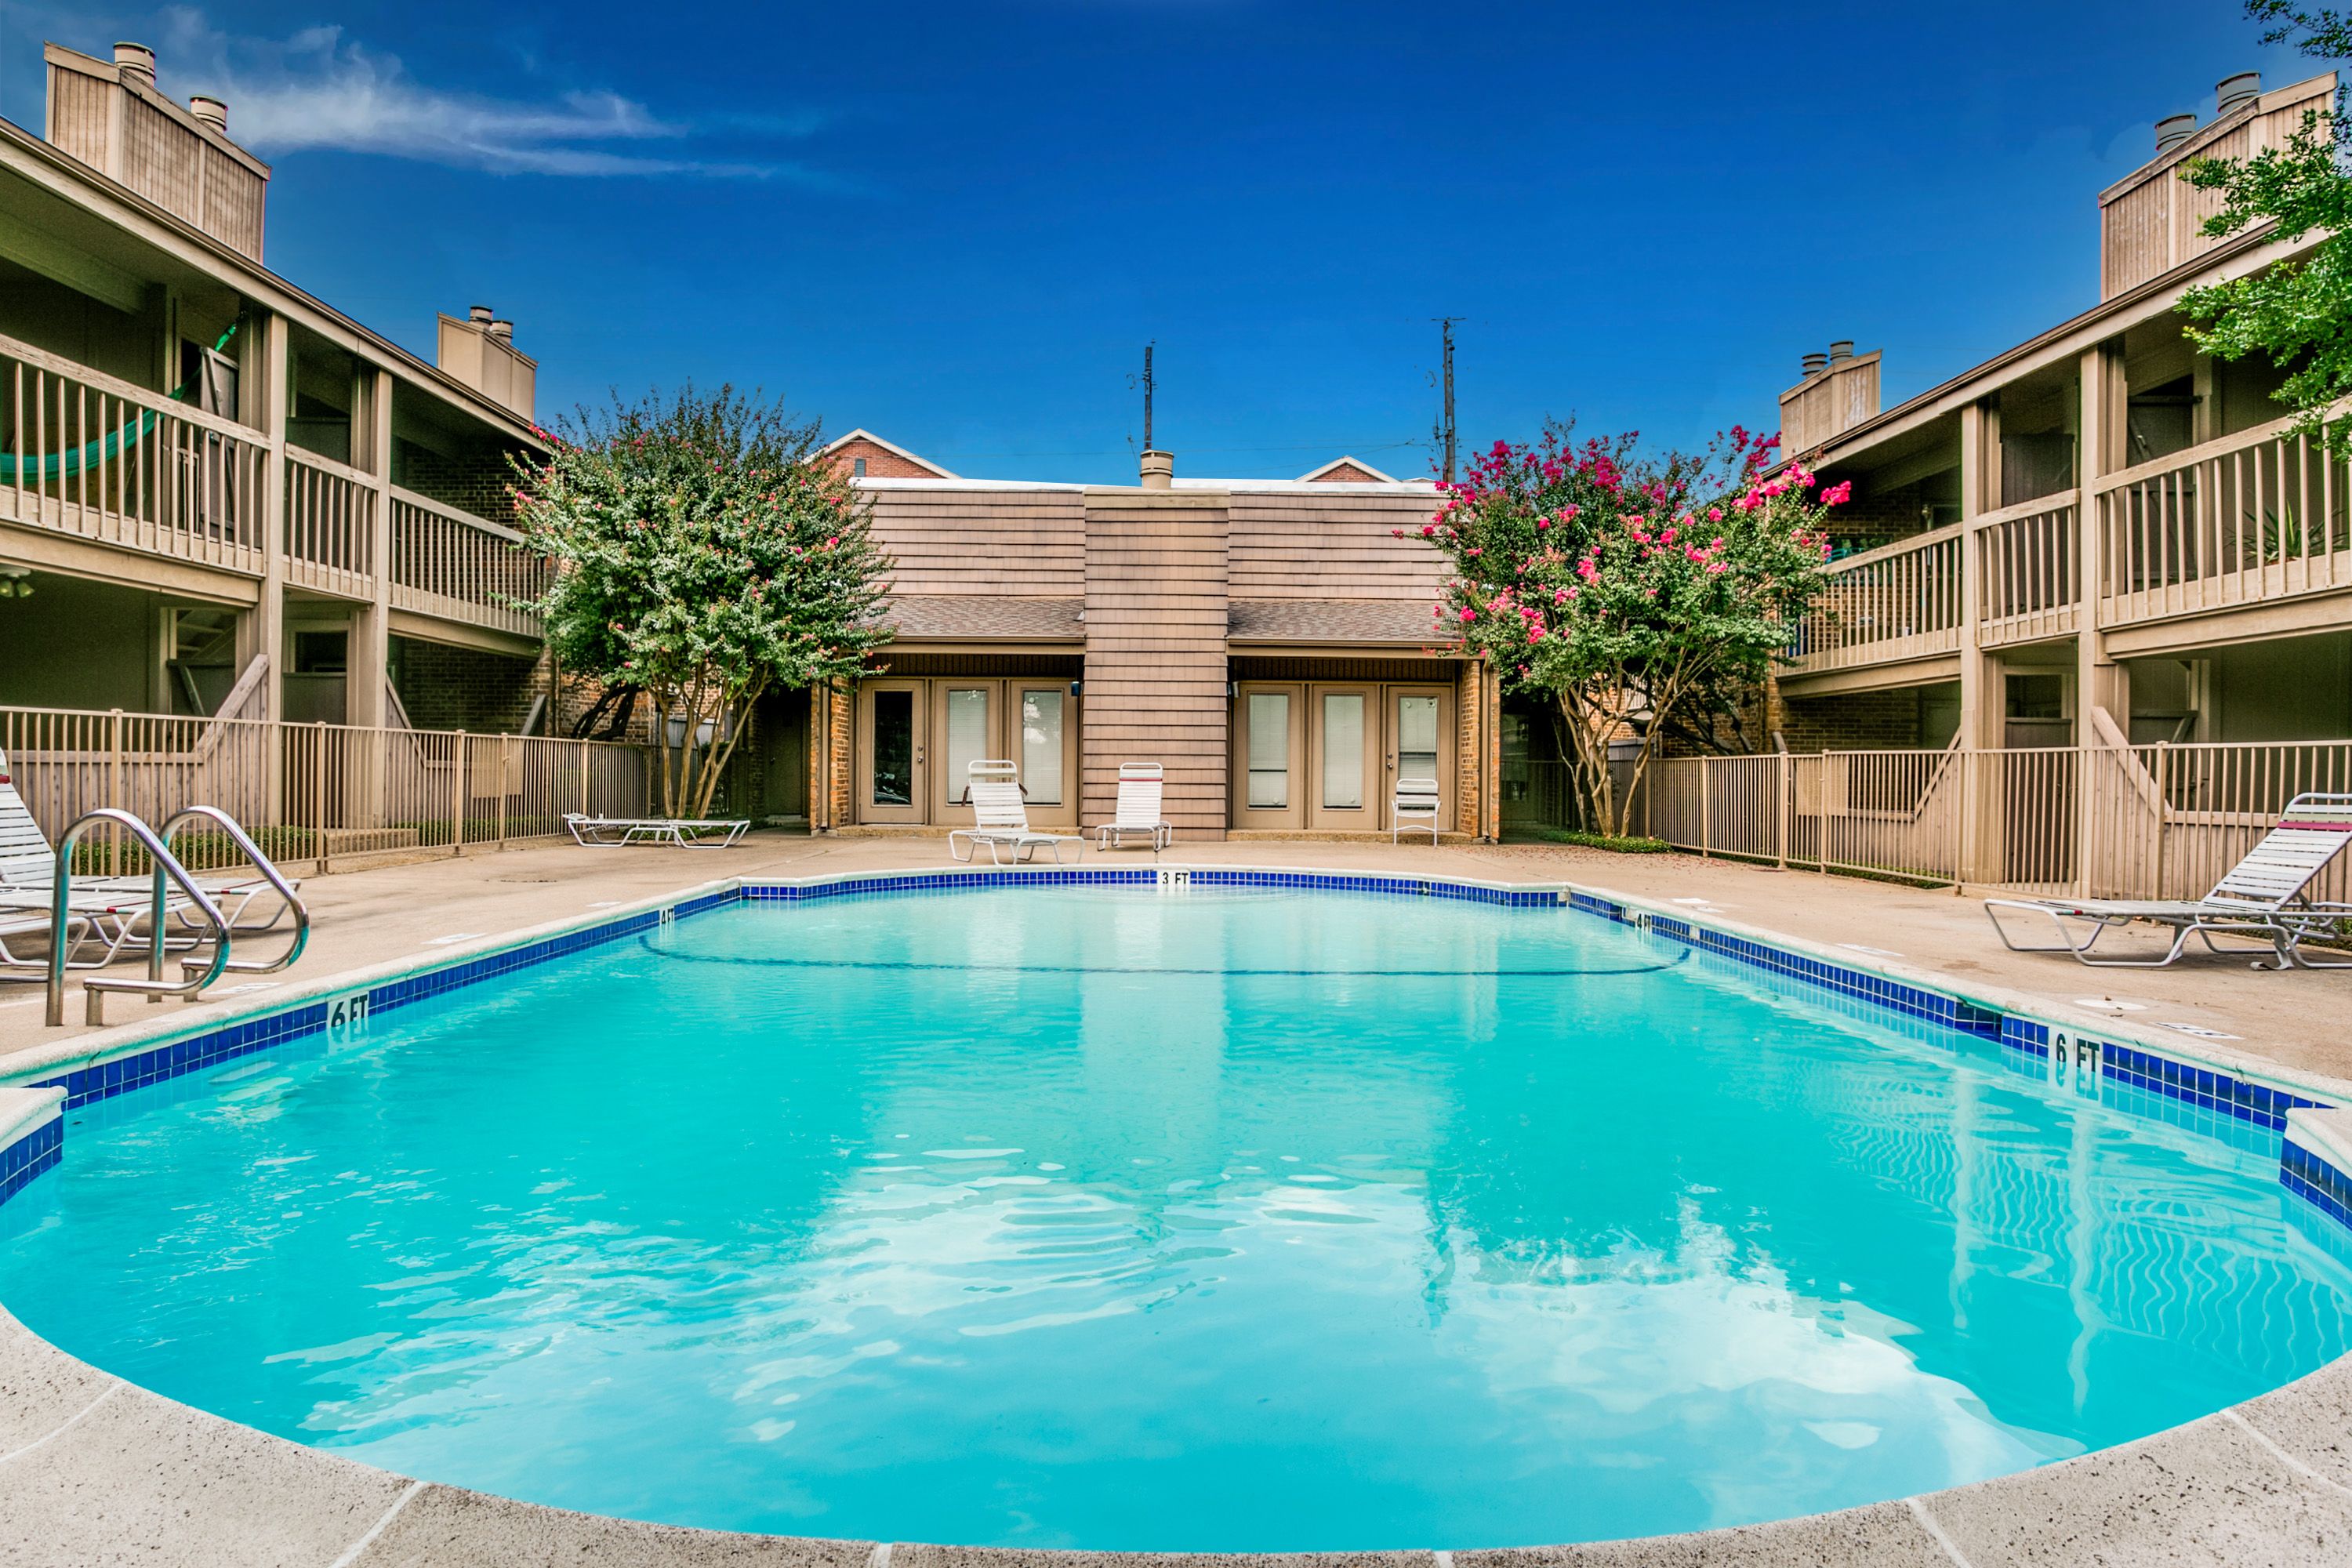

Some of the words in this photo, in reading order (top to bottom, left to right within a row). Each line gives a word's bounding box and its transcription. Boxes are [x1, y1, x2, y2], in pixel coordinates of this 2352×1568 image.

[1163, 872, 1169, 884] 3
[1175, 872, 1189, 884] FT
[661, 909, 666, 924] 4
[667, 908, 674, 923] FT
[1637, 913, 1642, 929] 4
[331, 1001, 345, 1028] 6
[350, 993, 368, 1022] FT
[2056, 1033, 2067, 1063] 6
[2077, 1038, 2100, 1073] FT
